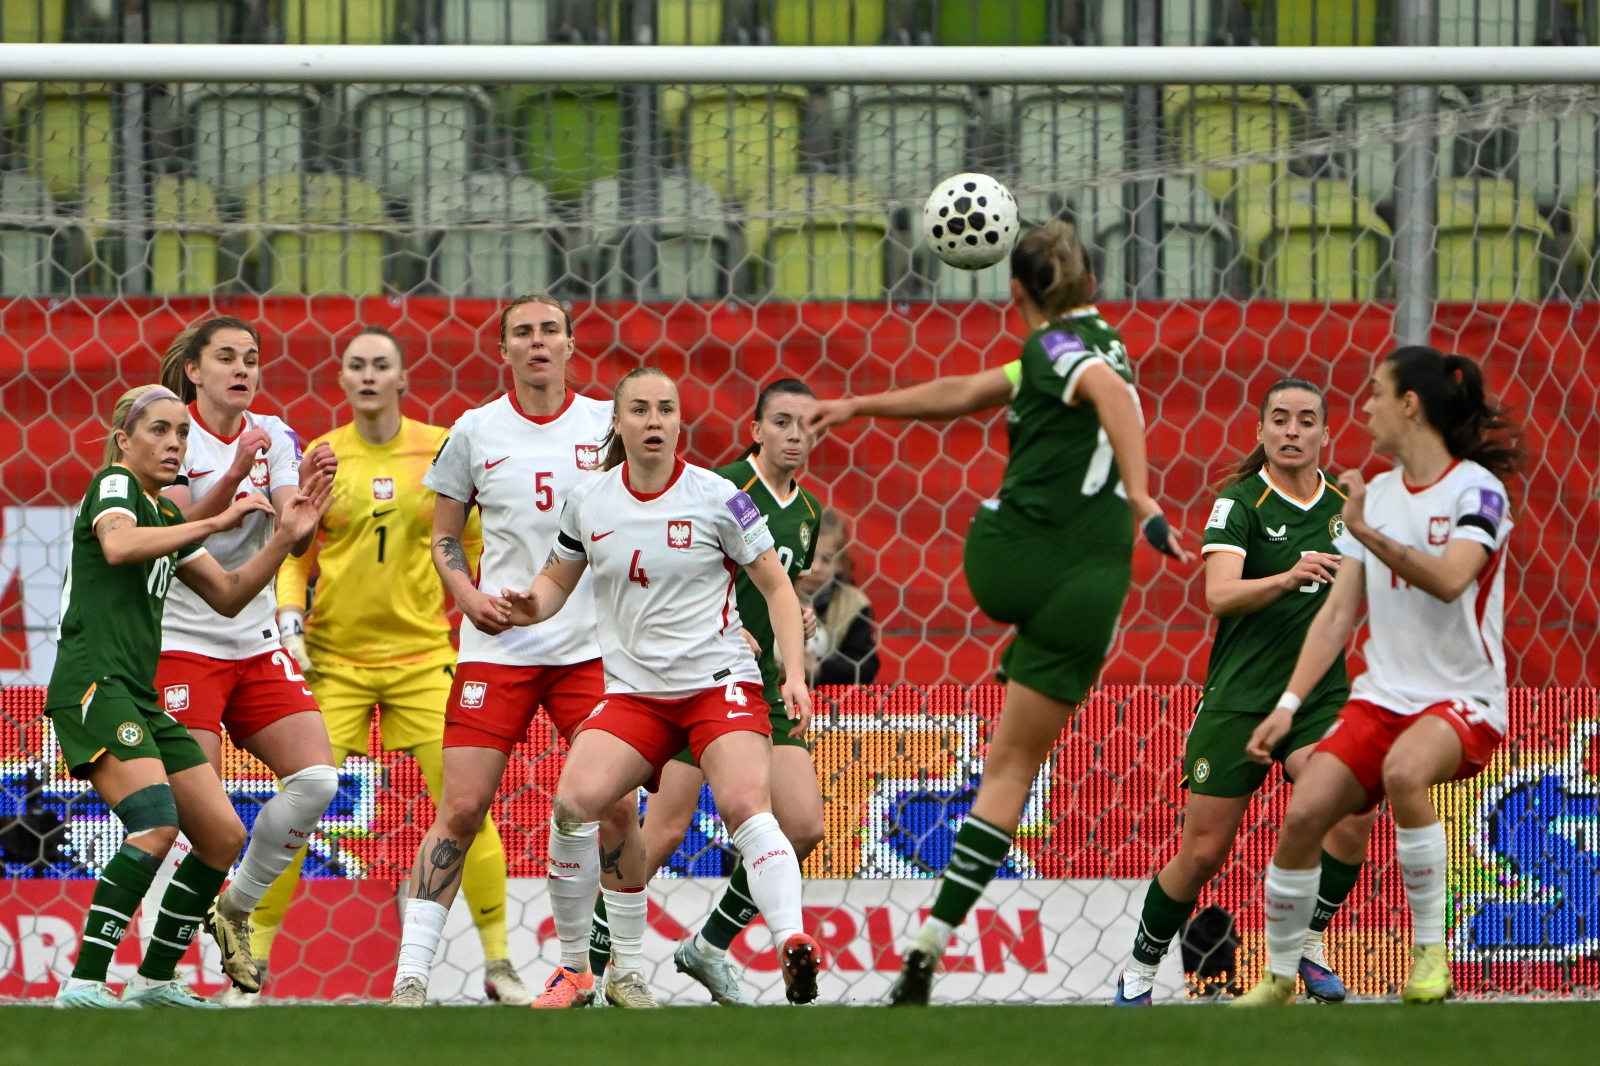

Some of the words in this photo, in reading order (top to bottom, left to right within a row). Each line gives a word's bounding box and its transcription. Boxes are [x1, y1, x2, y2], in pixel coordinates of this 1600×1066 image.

[535, 472, 554, 512] 5
[375, 525, 387, 563] 1
[147, 556, 170, 599] 10
[628, 549, 650, 589] 4
[725, 683, 748, 706] 4
[752, 849, 788, 869] POLSKA
